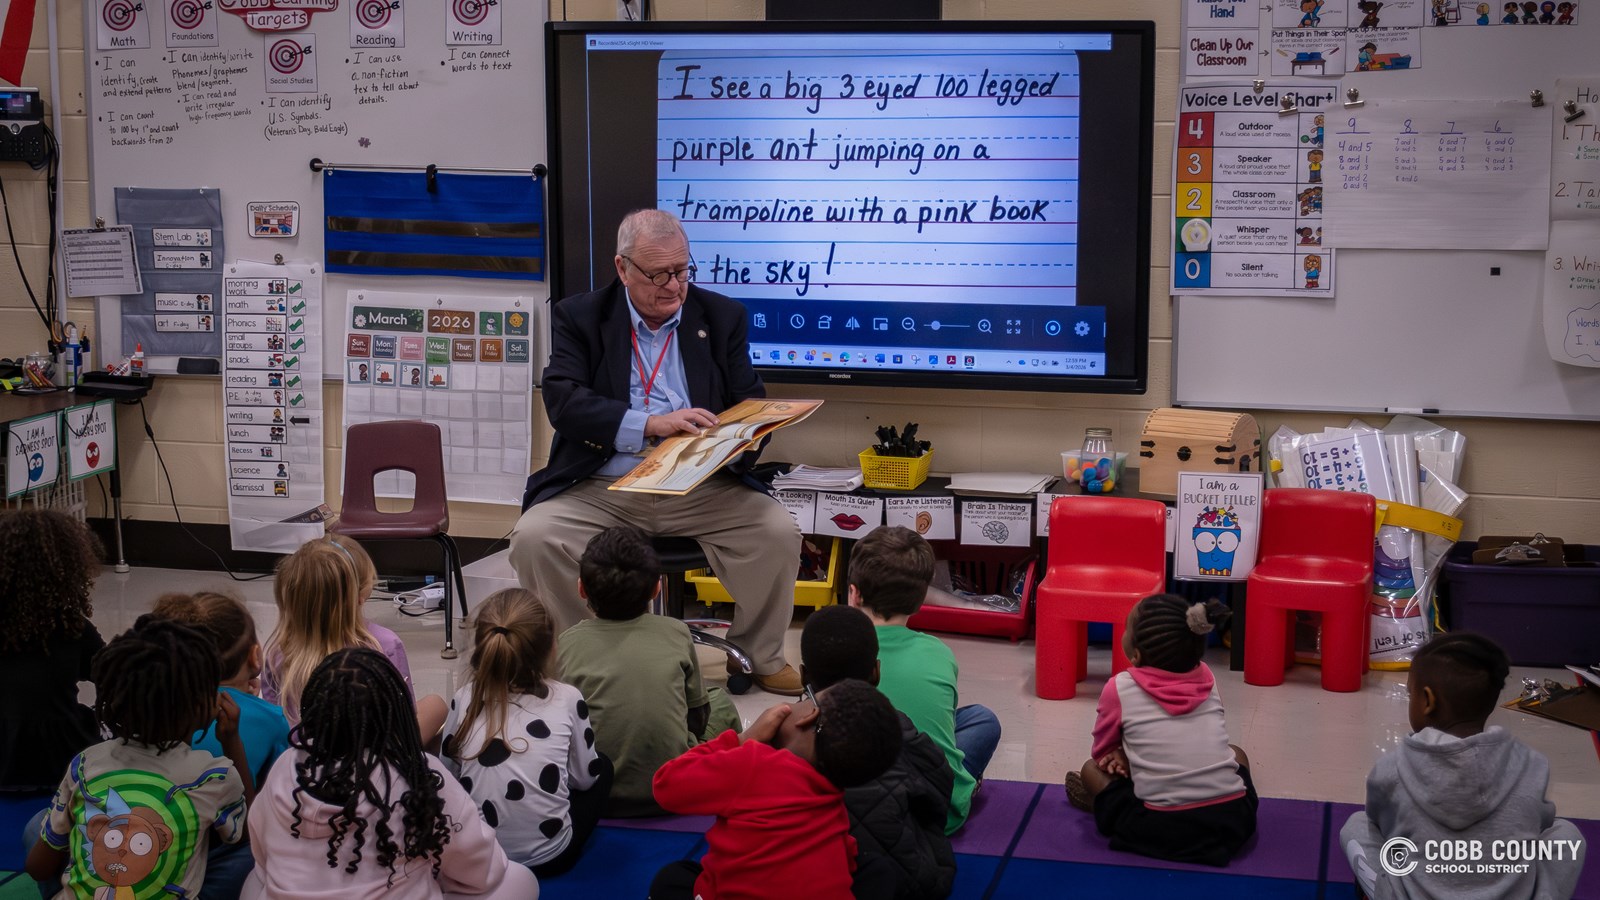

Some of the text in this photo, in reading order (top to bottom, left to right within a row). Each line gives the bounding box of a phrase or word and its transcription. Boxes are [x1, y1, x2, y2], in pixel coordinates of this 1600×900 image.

[1210, 6, 1234, 18] Hand
[248, 11, 307, 29] Targets
[110, 37, 136, 47] Math
[172, 32, 214, 40] Foundations
[356, 34, 396, 47] Reading
[453, 31, 493, 44] Writing
[1190, 37, 1254, 53] Clean Up Our
[353, 52, 402, 64] I can use
[448, 48, 511, 61] I can connect
[1197, 54, 1247, 66] Classroom
[452, 62, 512, 72] words to text
[352, 68, 408, 81] a non-fiction
[103, 86, 172, 98] and extend patterns
[673, 65, 1060, 114] I see a big 3 eyed 100 legged
[268, 94, 332, 111] I can identify
[1184, 92, 1228, 107] Voice
[1233, 92, 1279, 107] Level
[268, 112, 287, 126] U.S.
[1188, 118, 1204, 140] 4
[1238, 122, 1274, 130] Outdoor
[1348, 118, 1356, 133] 9
[1404, 118, 1412, 133] 8
[1447, 121, 1455, 132] 7
[1494, 120, 1502, 133] 6
[672, 128, 991, 175] purple ant jumping on a
[1338, 140, 1373, 152] 4 and 5
[1187, 153, 1202, 174] 3
[1238, 155, 1272, 163] Speaker
[1186, 188, 1202, 210] 2
[1232, 190, 1276, 198] Classroom
[250, 204, 268, 212] Daily
[678, 184, 1050, 234] trampoline with a pink book
[1236, 226, 1270, 234] Whisper
[154, 232, 192, 242] Stem Lab
[157, 254, 195, 262] Innovation
[710, 254, 751, 284] the
[1185, 258, 1200, 280] 0
[228, 280, 258, 290] morning
[368, 312, 408, 326] March
[432, 316, 471, 328] 2026
[228, 342, 253, 350] groups
[352, 338, 366, 346] Sun.
[376, 340, 392, 348] Mon.
[428, 342, 447, 350] Wed.
[510, 344, 524, 352] Sat.
[228, 356, 250, 364] snack
[228, 375, 256, 385] reading
[96, 411, 100, 422] A
[230, 412, 253, 421] writing
[26, 426, 45, 441] I AM A
[94, 422, 107, 434] SPOT
[230, 429, 250, 437] lunch
[42, 436, 55, 450] SPOT
[1200, 478, 1240, 492] I am a
[1308, 478, 1322, 489] 10
[1334, 474, 1344, 486] 3
[232, 484, 264, 492] dismissal
[786, 492, 812, 500] Looking
[825, 494, 847, 502] Mouth
[858, 498, 876, 506] Quiet
[888, 498, 908, 506] Ears
[920, 498, 952, 506] Listening
[1183, 492, 1257, 506] BUCKET FILLER
[967, 502, 986, 510] Brain
[998, 504, 1026, 512] Thinking
